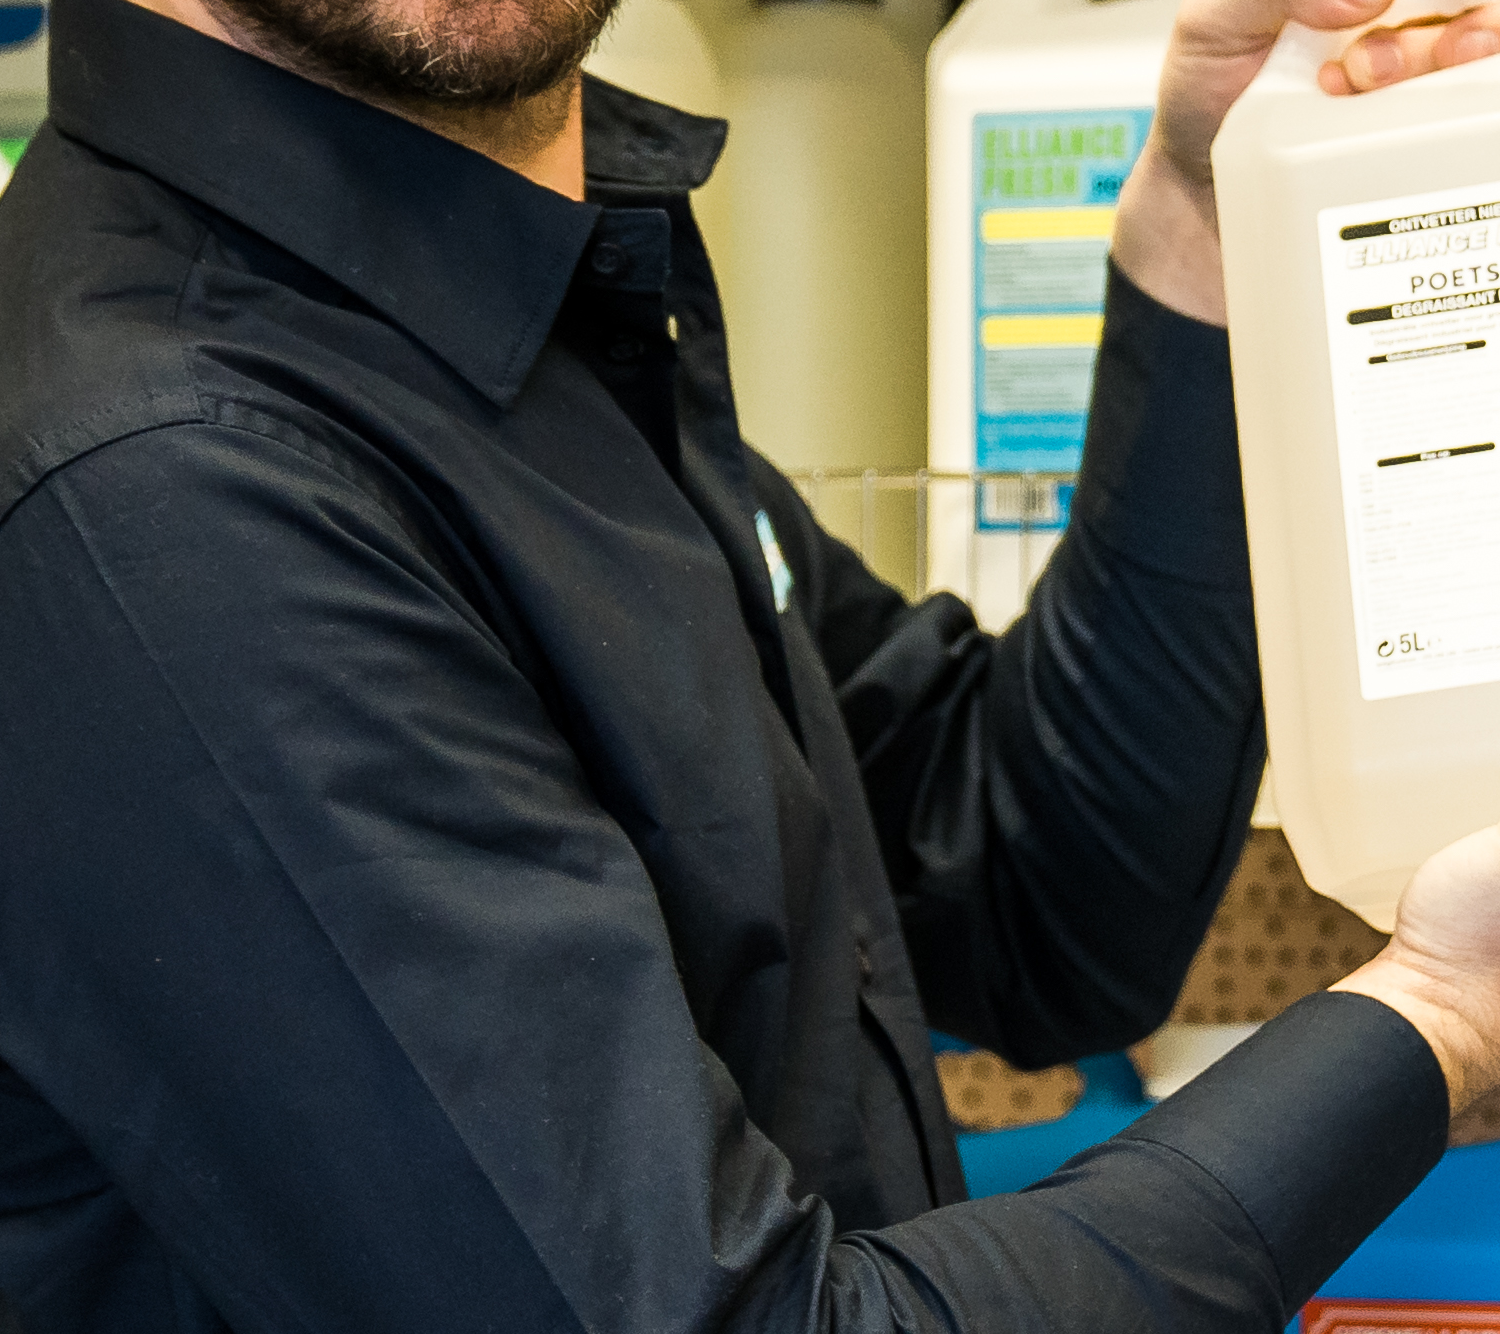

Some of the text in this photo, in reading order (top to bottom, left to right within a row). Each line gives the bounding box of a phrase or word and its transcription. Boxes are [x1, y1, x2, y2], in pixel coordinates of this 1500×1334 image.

[983, 124, 1127, 159] ELLIANCE
[1389, 207, 1476, 233] ONTVETTER
[1346, 226, 1487, 269] ELLIANCE
[1391, 290, 1497, 319] DEGRAISSANT
[1399, 632, 1425, 654] 5L
